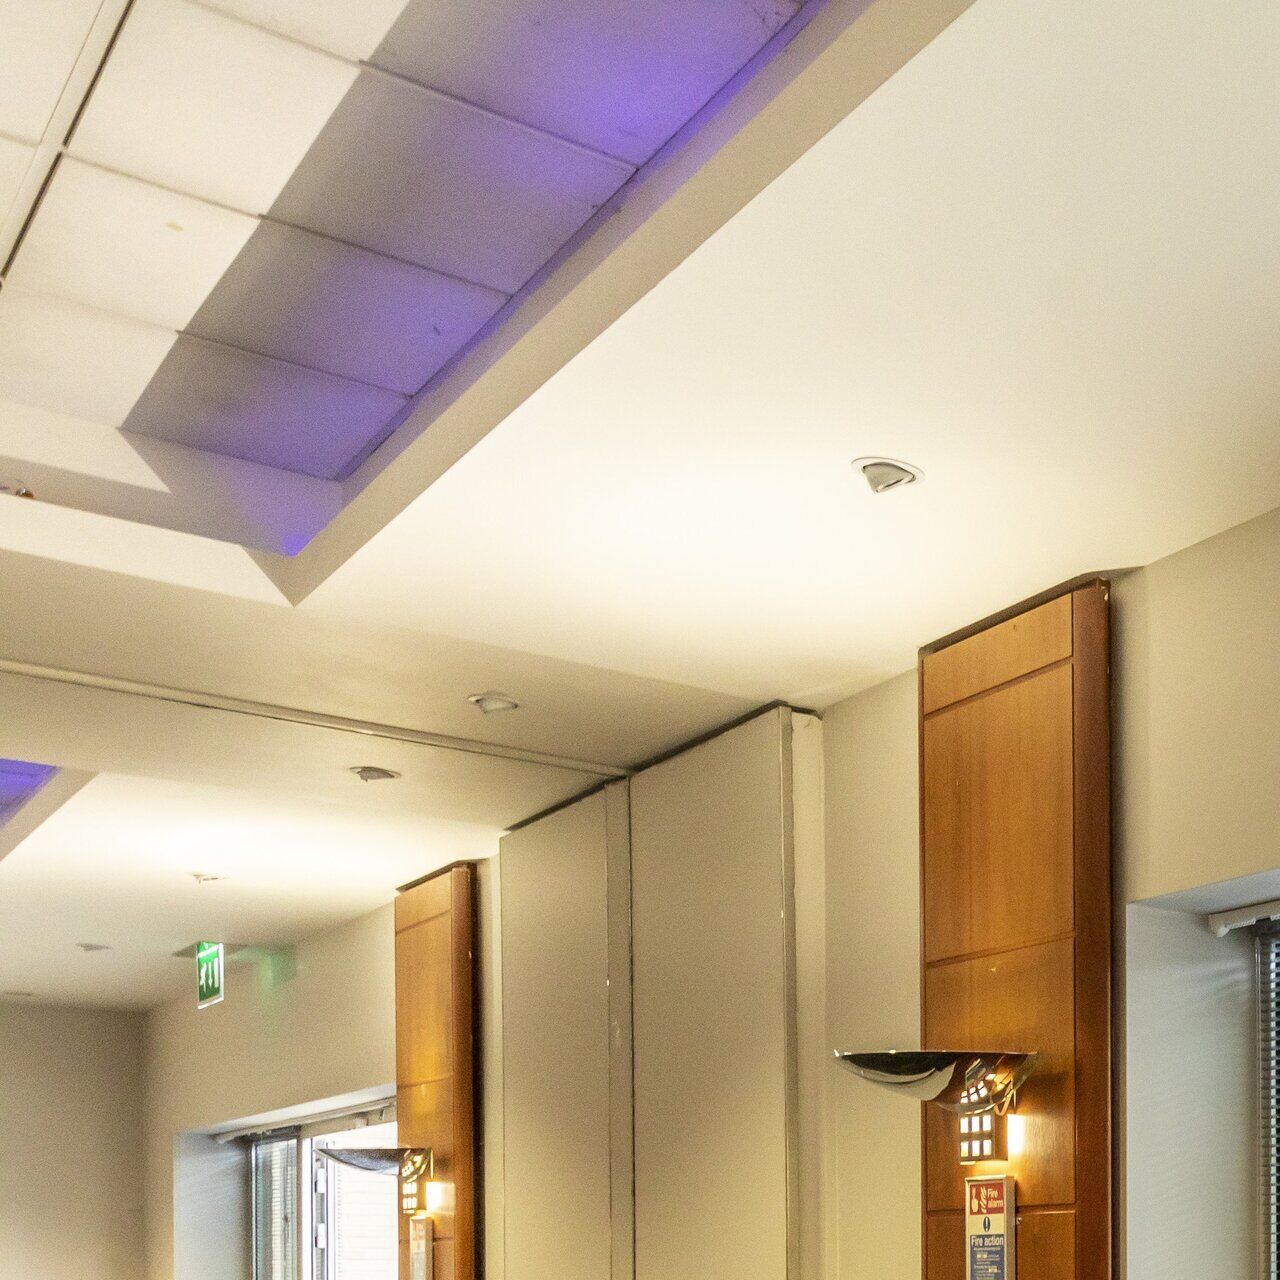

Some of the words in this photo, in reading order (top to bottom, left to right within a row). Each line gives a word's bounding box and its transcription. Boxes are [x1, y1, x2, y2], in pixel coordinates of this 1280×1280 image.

[987, 1188, 998, 1198] Fire
[987, 1199, 1003, 1208] alarm
[971, 1236, 983, 1247] Fire
[984, 1235, 1004, 1247] action
